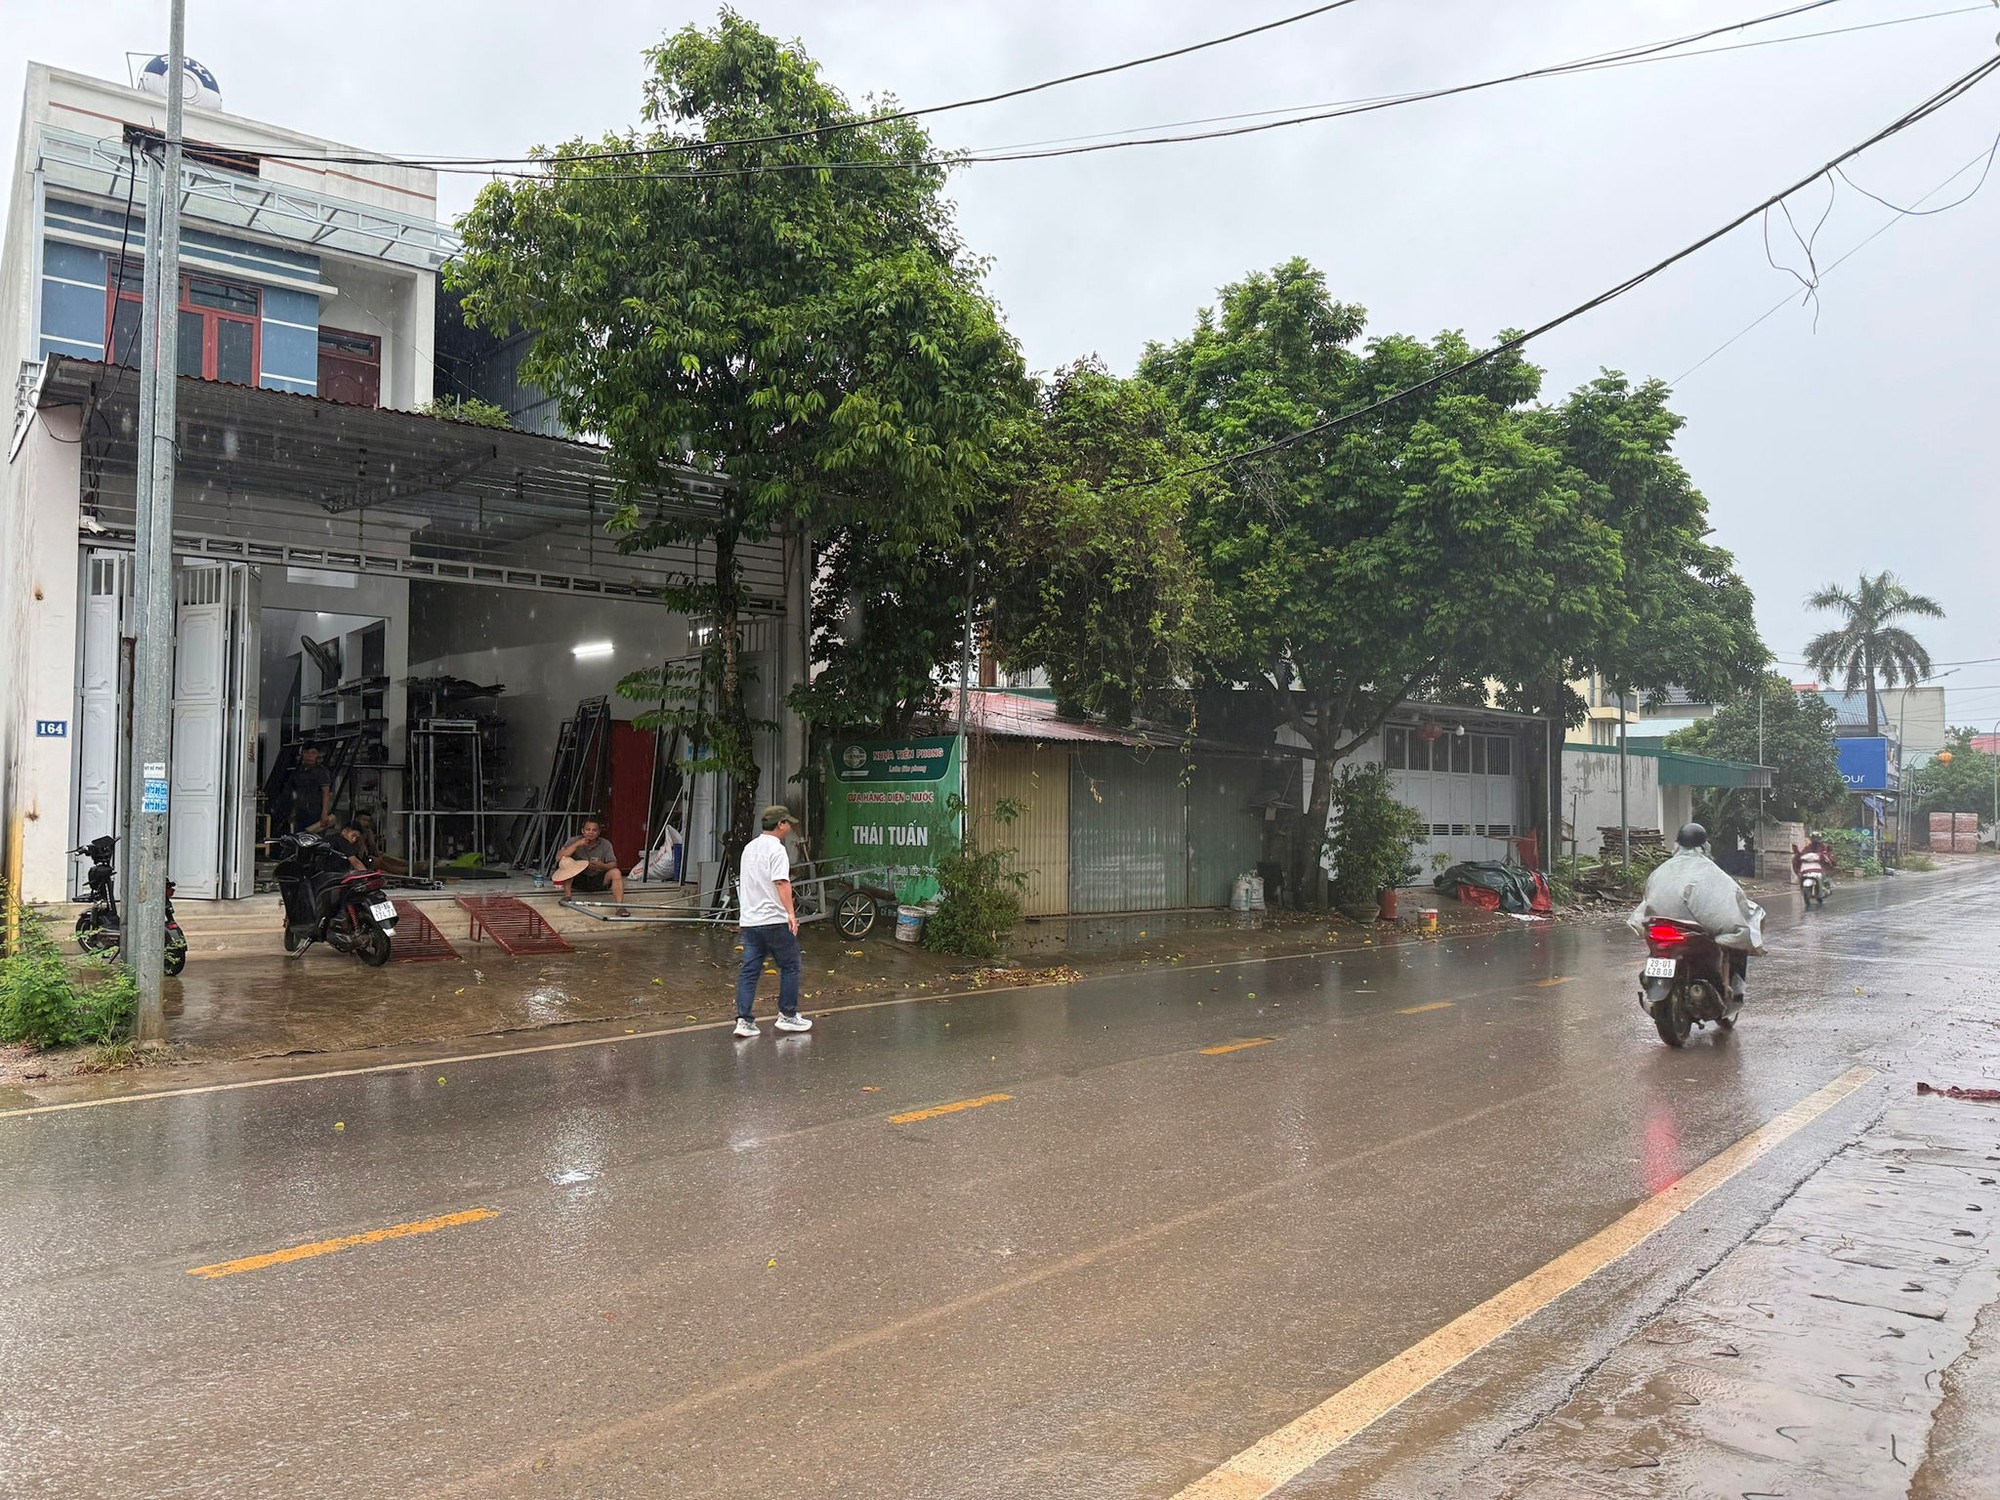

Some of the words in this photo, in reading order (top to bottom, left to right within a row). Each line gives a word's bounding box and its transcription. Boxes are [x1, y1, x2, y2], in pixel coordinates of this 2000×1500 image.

[40, 723, 63, 734] 164
[916, 747, 944, 759] PHONG
[1841, 774, 1866, 783] our
[852, 822, 884, 845] THÁI
[888, 819, 929, 846] TUẤN
